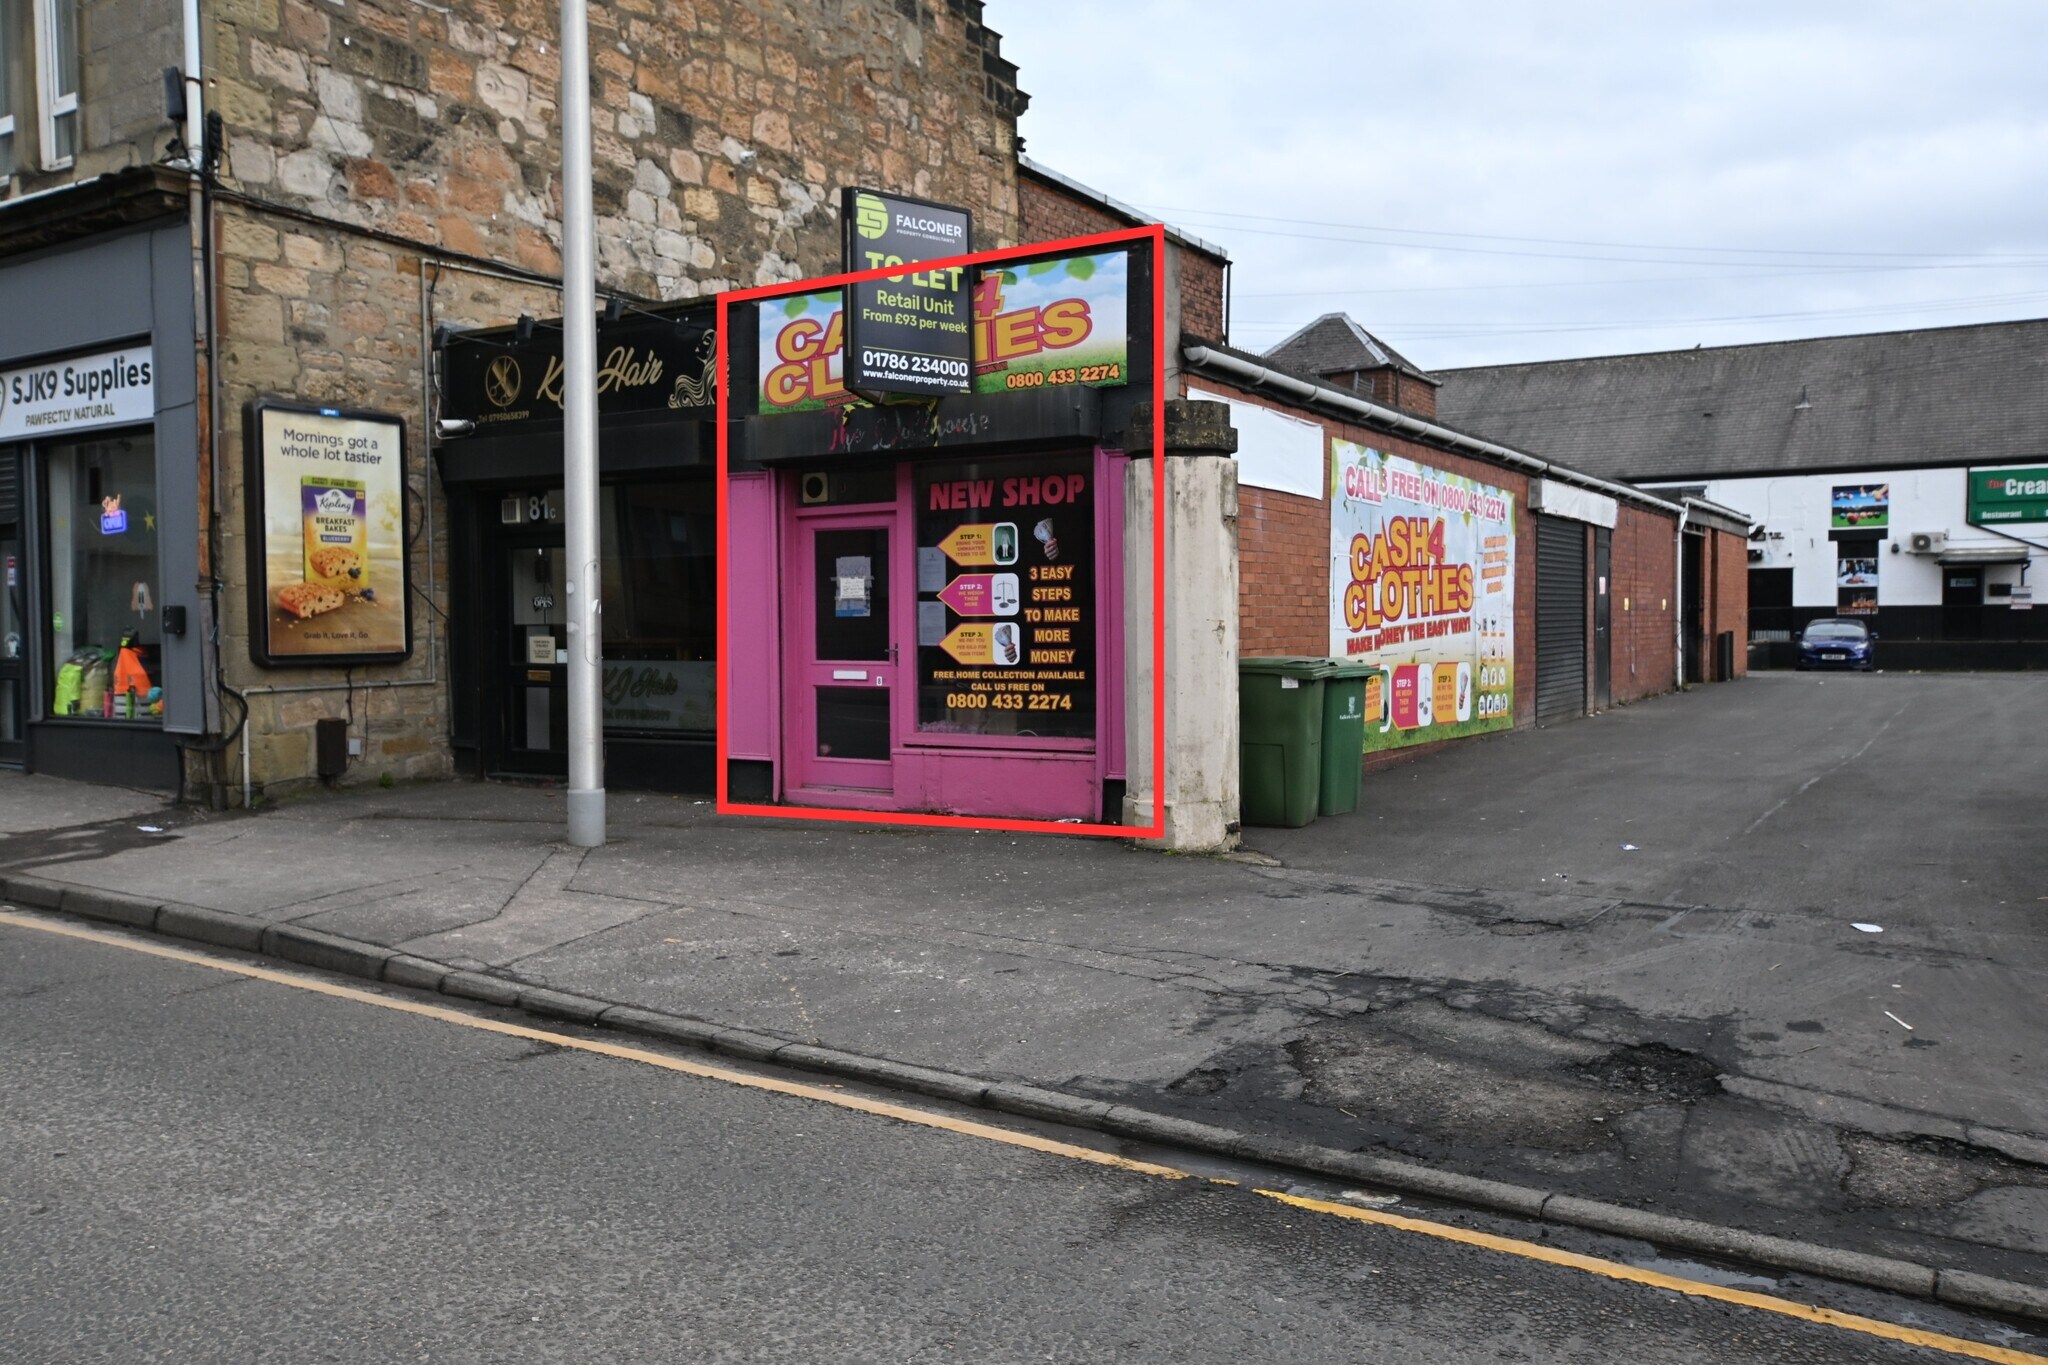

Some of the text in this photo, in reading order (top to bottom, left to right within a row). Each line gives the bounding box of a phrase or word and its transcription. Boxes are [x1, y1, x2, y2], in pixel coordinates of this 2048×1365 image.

[896, 214, 962, 238] FALCONER
[877, 290, 954, 315] Retail Unit
[863, 309, 967, 334] From £93 per week
[597, 346, 664, 394] Hair
[863, 351, 909, 370] 01786
[911, 357, 968, 377] 234000
[12, 355, 152, 405] SJK9 Supplies
[862, 369, 969, 388] www.falconerproperty.co.uk
[1006, 364, 1119, 389] 0800 433 2274
[25, 403, 115, 427] PAWFECTLY NATURAL
[283, 428, 378, 450] Mornings got a
[280, 445, 382, 465] whole lot tastier
[929, 474, 1085, 510] NEW SHOP
[1345, 465, 1382, 504] CALL
[1391, 470, 1421, 503] FREE
[1423, 480, 1440, 506] ON
[1442, 484, 1466, 513] 0800
[1467, 491, 1483, 517] 433
[1485, 497, 1506, 522] 2274
[2005, 478, 2048, 496] Crea
[320, 497, 351, 512] Kipling
[315, 517, 355, 526] BREAKFAST
[1981, 510, 2022, 520] Restaurant
[324, 525, 347, 533] BAKES
[1029, 565, 1074, 580] 3 EASY
[1032, 587, 1072, 601] STEPS
[1344, 562, 1475, 633] CLOTHES
[1024, 607, 1080, 622] TO MAKE
[304, 631, 321, 639] Grab
[331, 631, 349, 639] Love
[358, 631, 369, 639] Go
[1033, 628, 1071, 643] MORE
[1346, 625, 1373, 656] MAKE
[1374, 624, 1405, 651] MONEY
[1407, 622, 1426, 642] THE
[1426, 618, 1450, 639] EASY
[1030, 649, 1075, 664] MONEY
[933, 671, 1085, 680] FREE HOME COLLECTION AVAILABLE
[1396, 679, 1407, 688] STEP
[971, 683, 1045, 691] CALL US FREE ON
[946, 693, 1072, 710] 0800 433 2274
